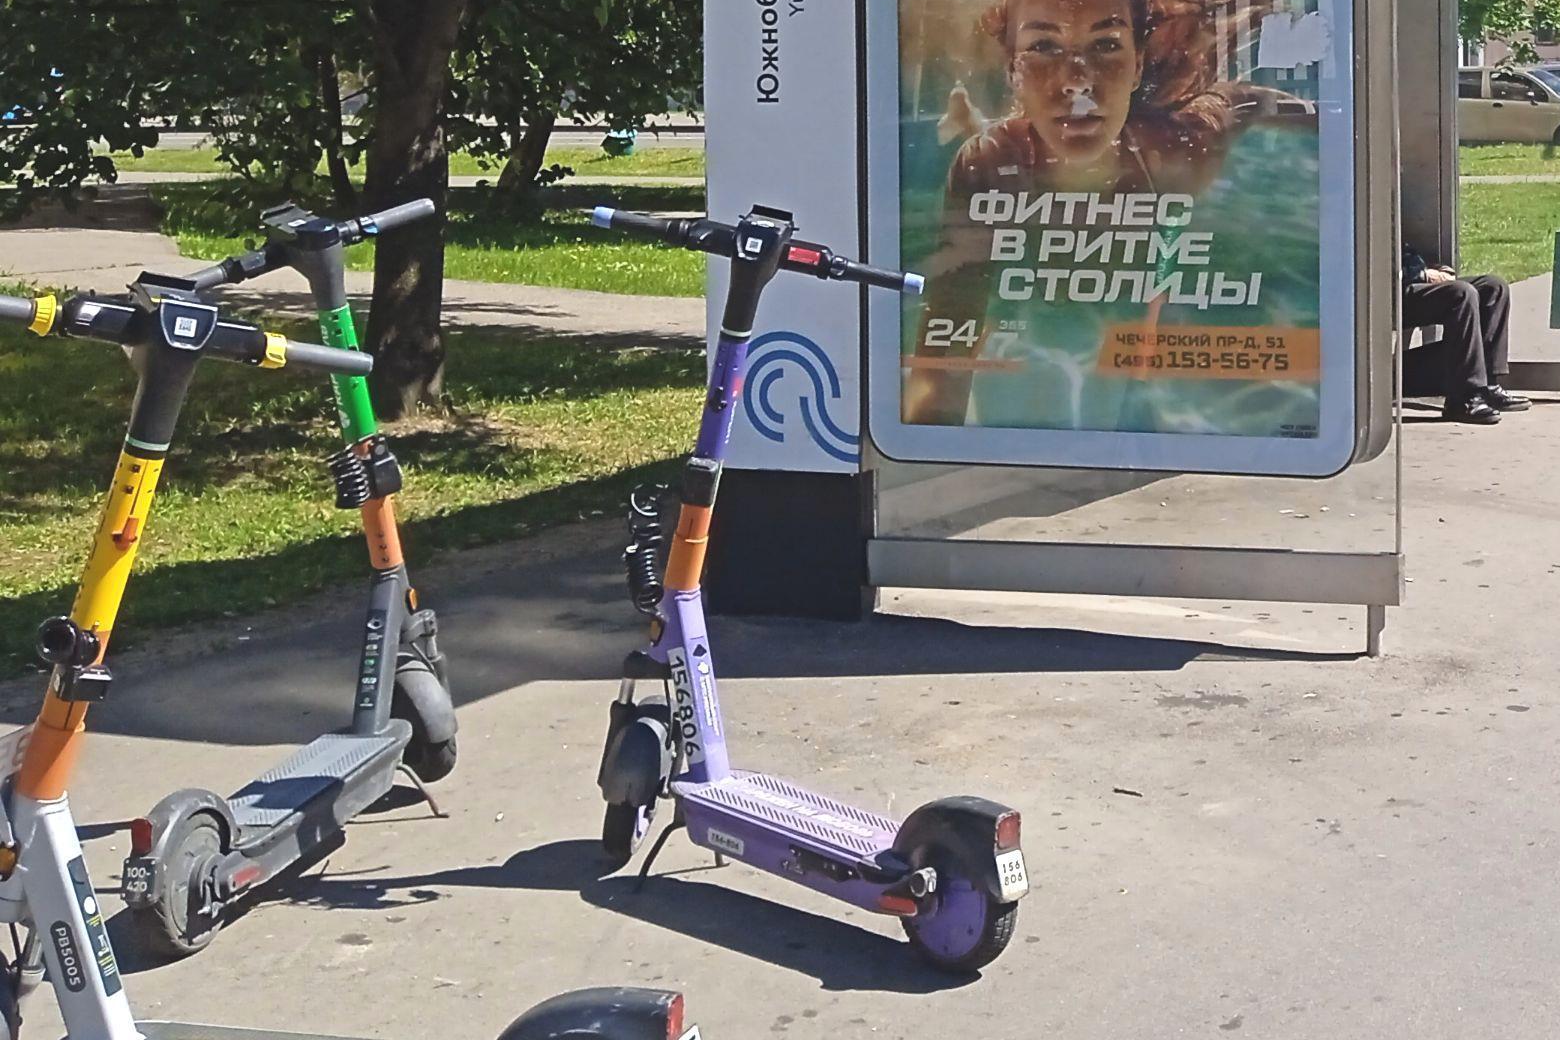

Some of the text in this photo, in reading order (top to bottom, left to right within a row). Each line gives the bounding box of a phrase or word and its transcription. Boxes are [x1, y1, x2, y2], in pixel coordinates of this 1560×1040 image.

[968, 189, 1195, 227] ФИТНЕС
[990, 229, 1026, 262] В
[1037, 229, 1214, 266] РИТМЕ
[998, 267, 1263, 311] СТОЛИЦЫ
[923, 317, 980, 348] 24
[1265, 336, 1286, 349] 51
[1166, 351, 1289, 371] 153-56-75
[671, 655, 701, 757] 156806
[127, 866, 151, 879] 100-
[1002, 859, 1021, 874] 156
[1004, 871, 1023, 886] 806
[126, 880, 148, 892] 420
[55, 926, 81, 986] PB5005
